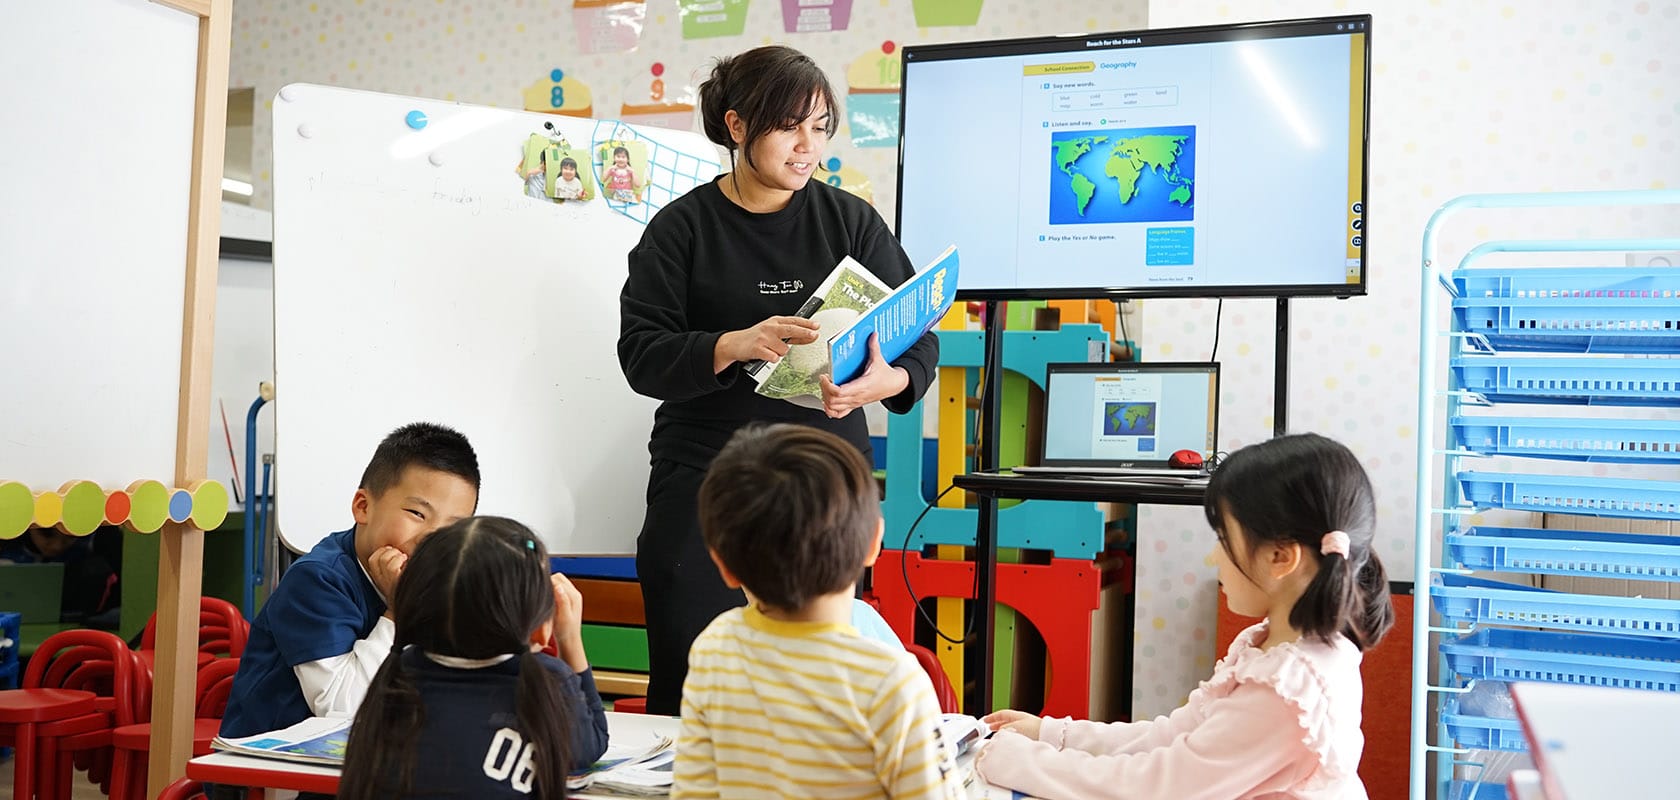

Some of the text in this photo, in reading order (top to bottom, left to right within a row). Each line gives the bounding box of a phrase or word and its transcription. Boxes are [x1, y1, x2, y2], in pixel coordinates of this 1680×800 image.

[880, 57, 900, 84] 10
[1100, 61, 1137, 69] Geography
[551, 86, 564, 108] 8
[650, 79, 665, 101] 9
[842, 283, 860, 300] The
[847, 276, 860, 286] Unit
[483, 727, 537, 794] 06
